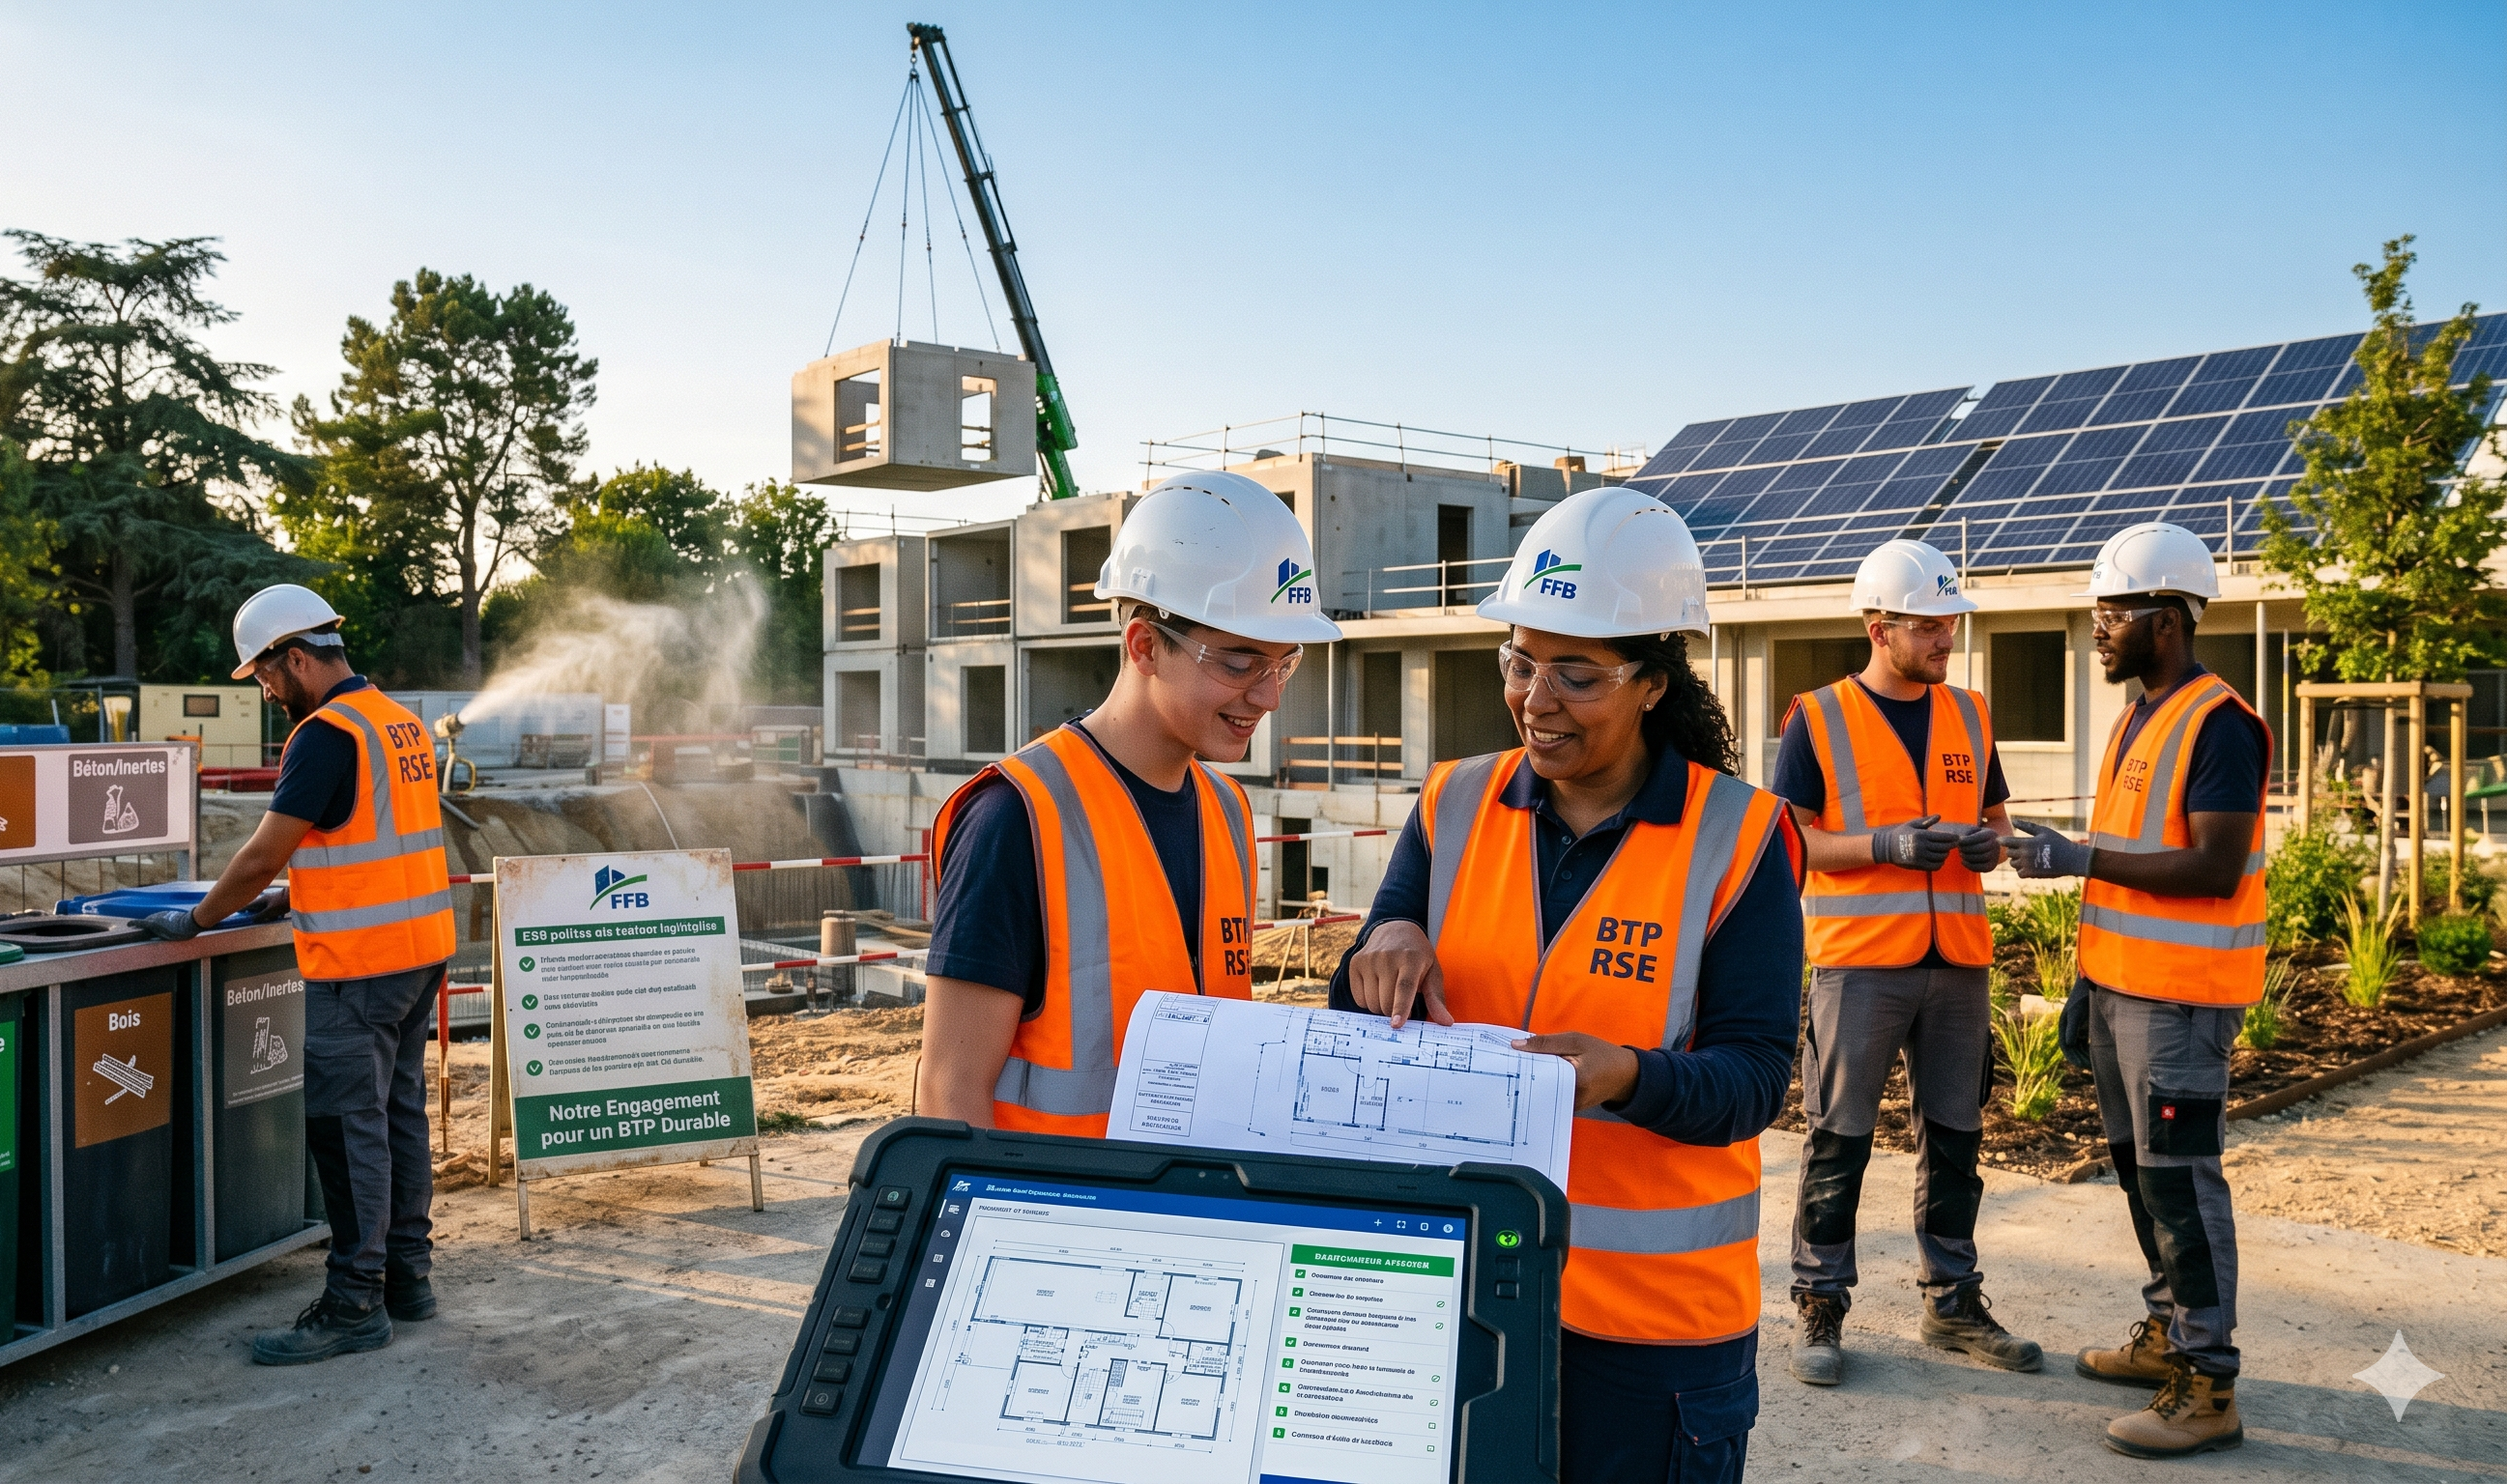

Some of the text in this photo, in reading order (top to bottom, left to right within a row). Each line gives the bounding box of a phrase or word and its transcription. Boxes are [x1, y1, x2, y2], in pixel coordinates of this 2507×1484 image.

[1288, 587, 1311, 604] FFB
[1540, 578, 1577, 599] FFB
[385, 722, 420, 749] BTP
[72, 758, 165, 778] Béton/Inertes
[398, 752, 433, 784] RSE
[1942, 754, 1971, 767] BTP
[2126, 758, 2147, 774] BTP
[1945, 769, 1974, 784] RSE
[611, 892, 649, 909] FFB
[1597, 917, 1663, 947] BTP
[1589, 948, 1657, 984] RSE
[108, 1009, 141, 1032] Bois
[549, 1090, 721, 1122] Notre Engagement
[540, 1111, 731, 1149] pour un BTP Durable
